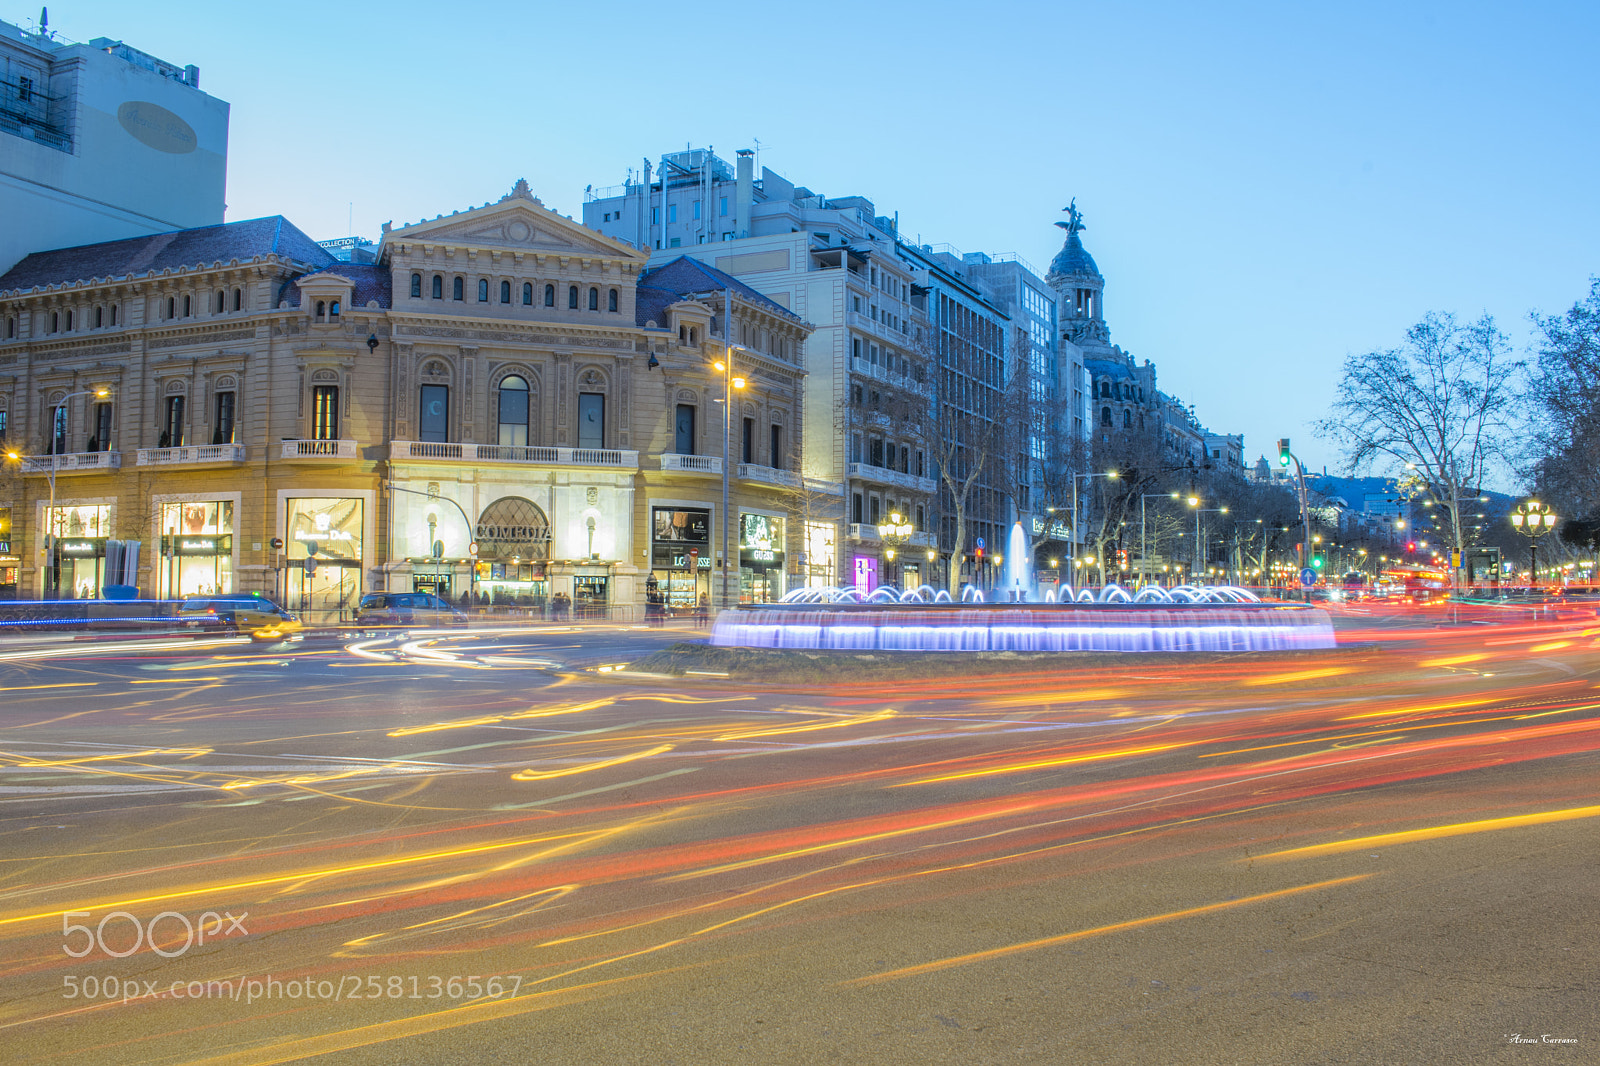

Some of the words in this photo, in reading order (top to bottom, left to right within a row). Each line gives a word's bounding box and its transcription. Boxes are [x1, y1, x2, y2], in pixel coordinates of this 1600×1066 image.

[320, 238, 355, 248] COLLECTION
[475, 524, 554, 541] COMEDIA
[753, 549, 774, 561] GUESS
[674, 556, 711, 567] LOSSE
